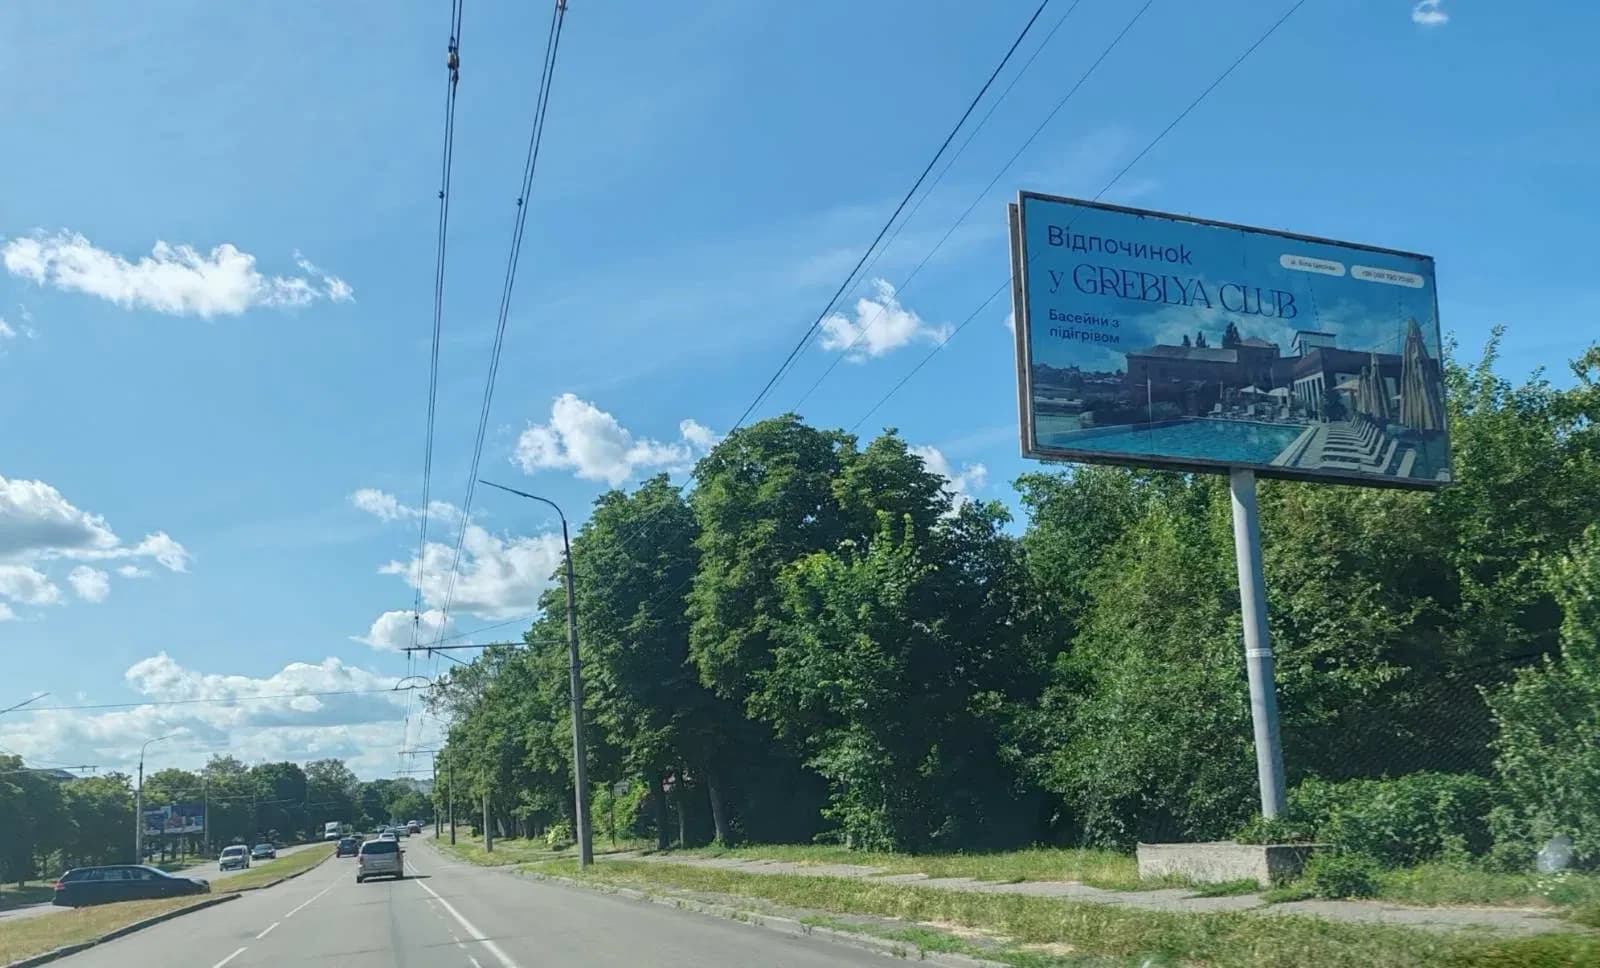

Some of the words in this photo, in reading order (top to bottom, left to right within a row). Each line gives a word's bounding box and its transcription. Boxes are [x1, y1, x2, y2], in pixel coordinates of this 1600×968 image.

[1048, 225, 1192, 265] Відпочинок
[1073, 264, 1212, 309] GREBLYA
[1219, 283, 1297, 319] CLUB
[1049, 308, 1109, 327] Басейни
[1111, 319, 1120, 328] з
[1049, 326, 1120, 344] підігрівом
